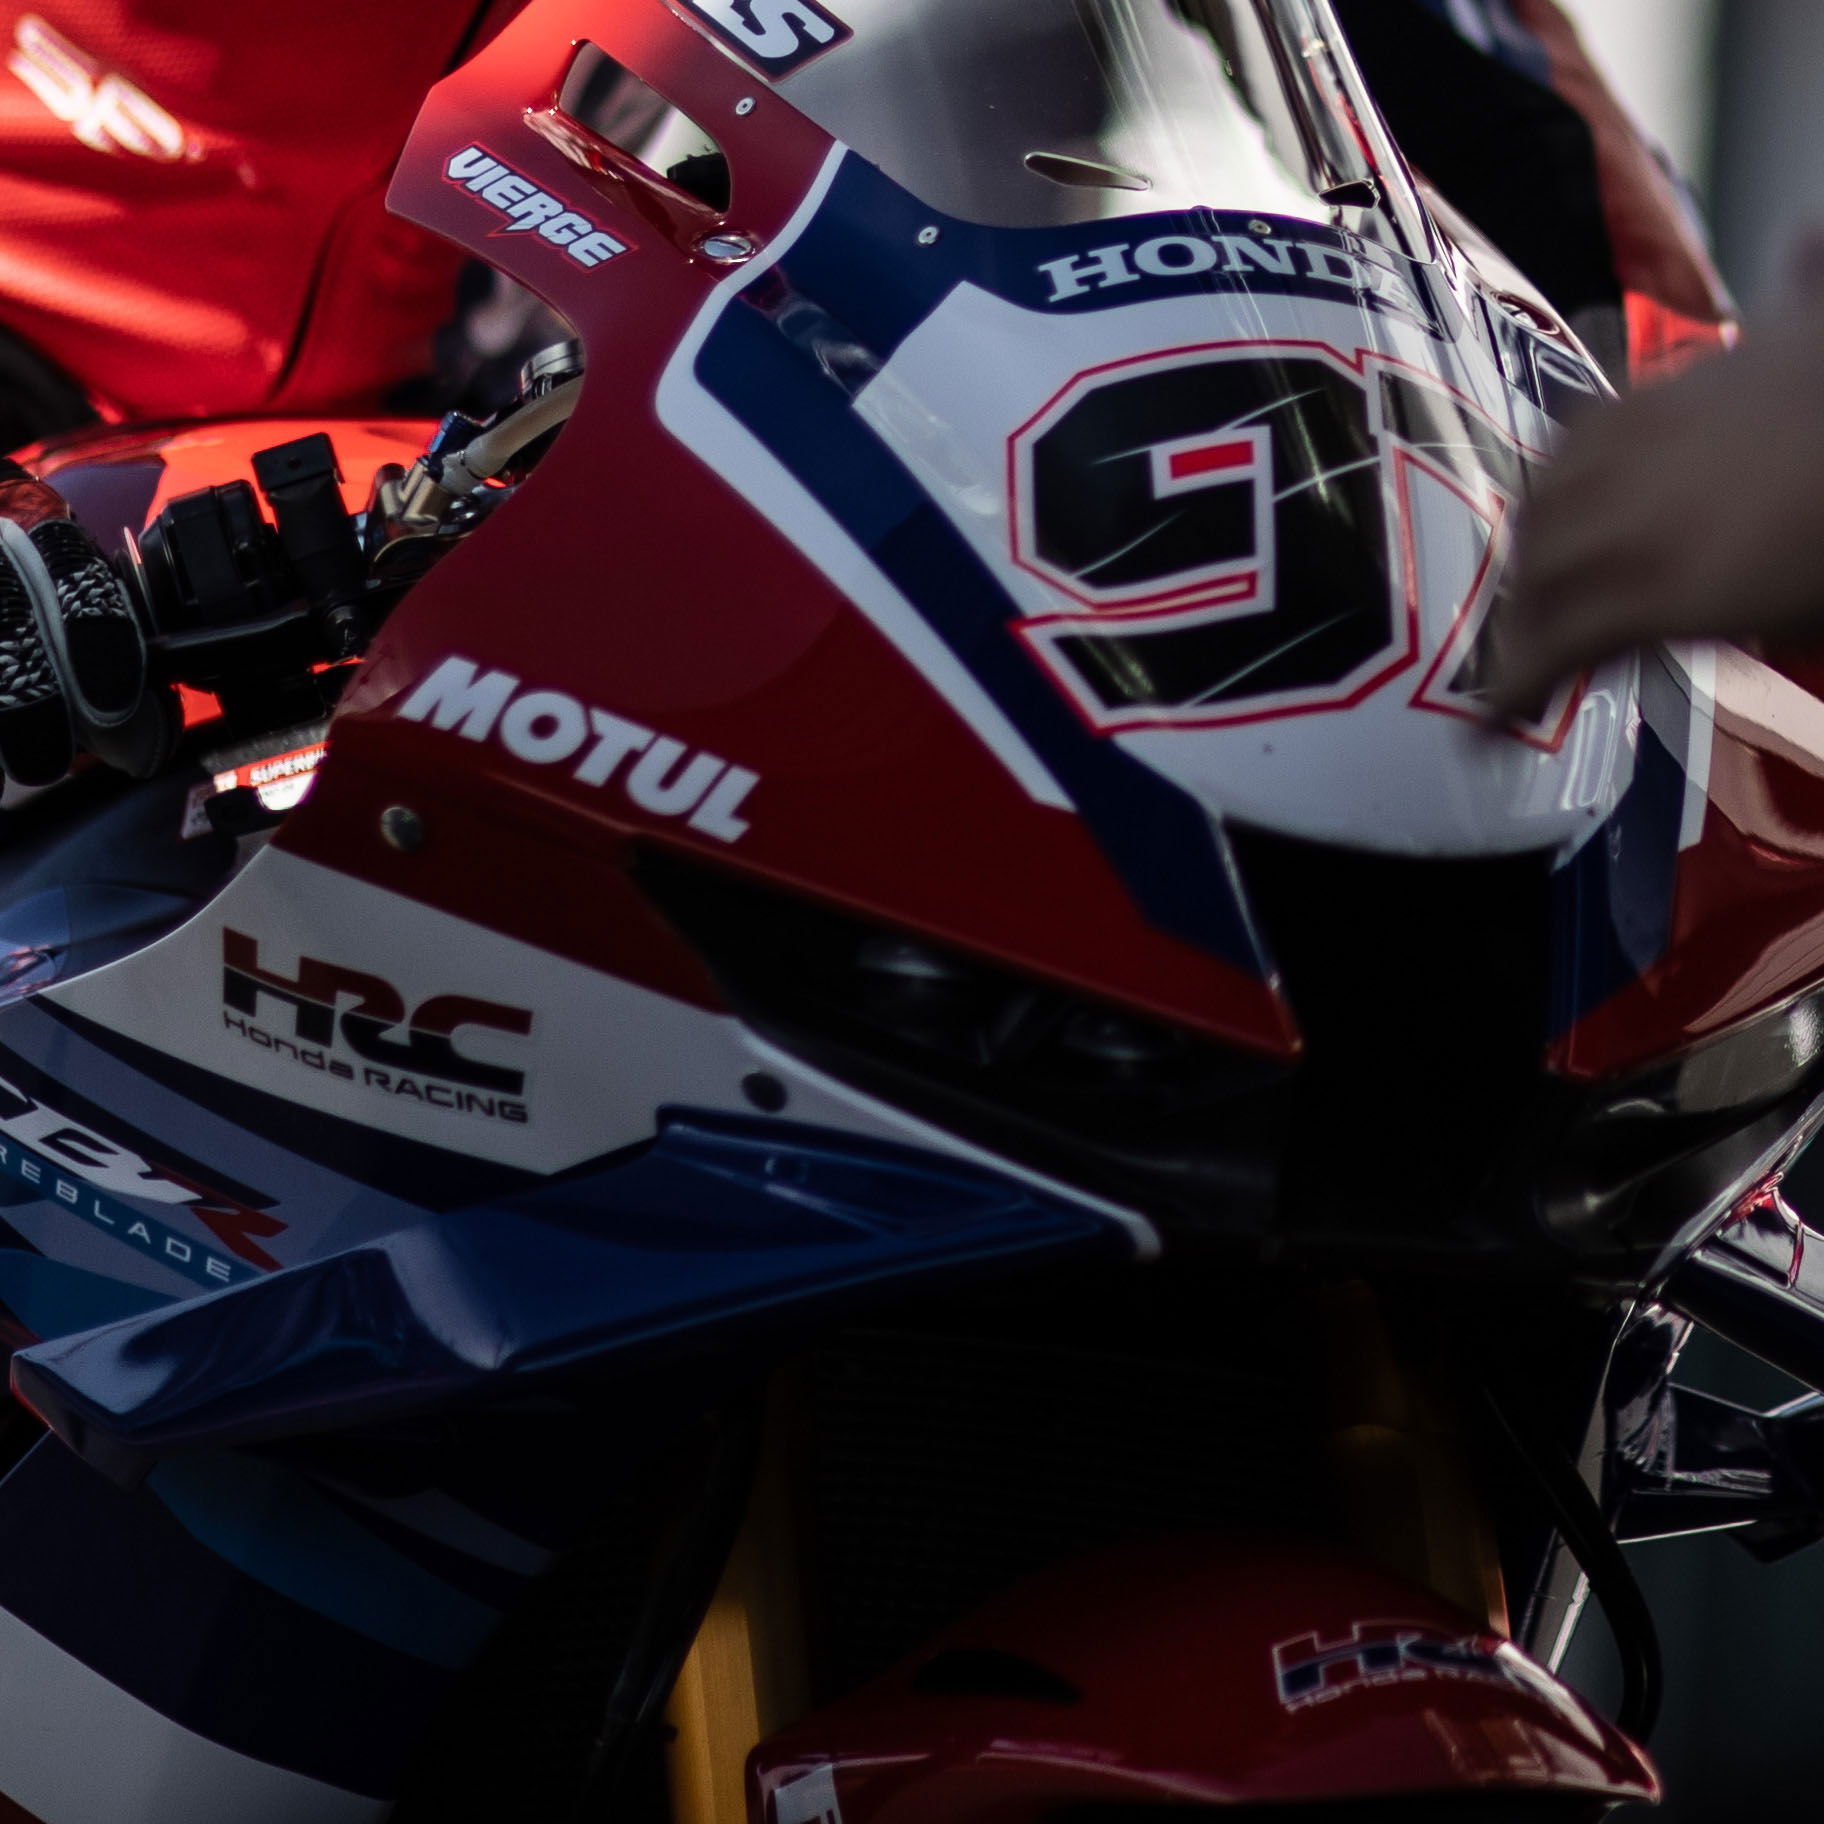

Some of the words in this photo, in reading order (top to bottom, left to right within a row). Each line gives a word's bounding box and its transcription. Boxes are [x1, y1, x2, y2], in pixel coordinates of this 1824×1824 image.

[448, 146, 628, 268] VIERGE
[396, 654, 761, 844] MOTUL
[222, 926, 534, 1096] HRC
[222, 1010, 354, 1081] Honda
[363, 1067, 528, 1124] RACING
